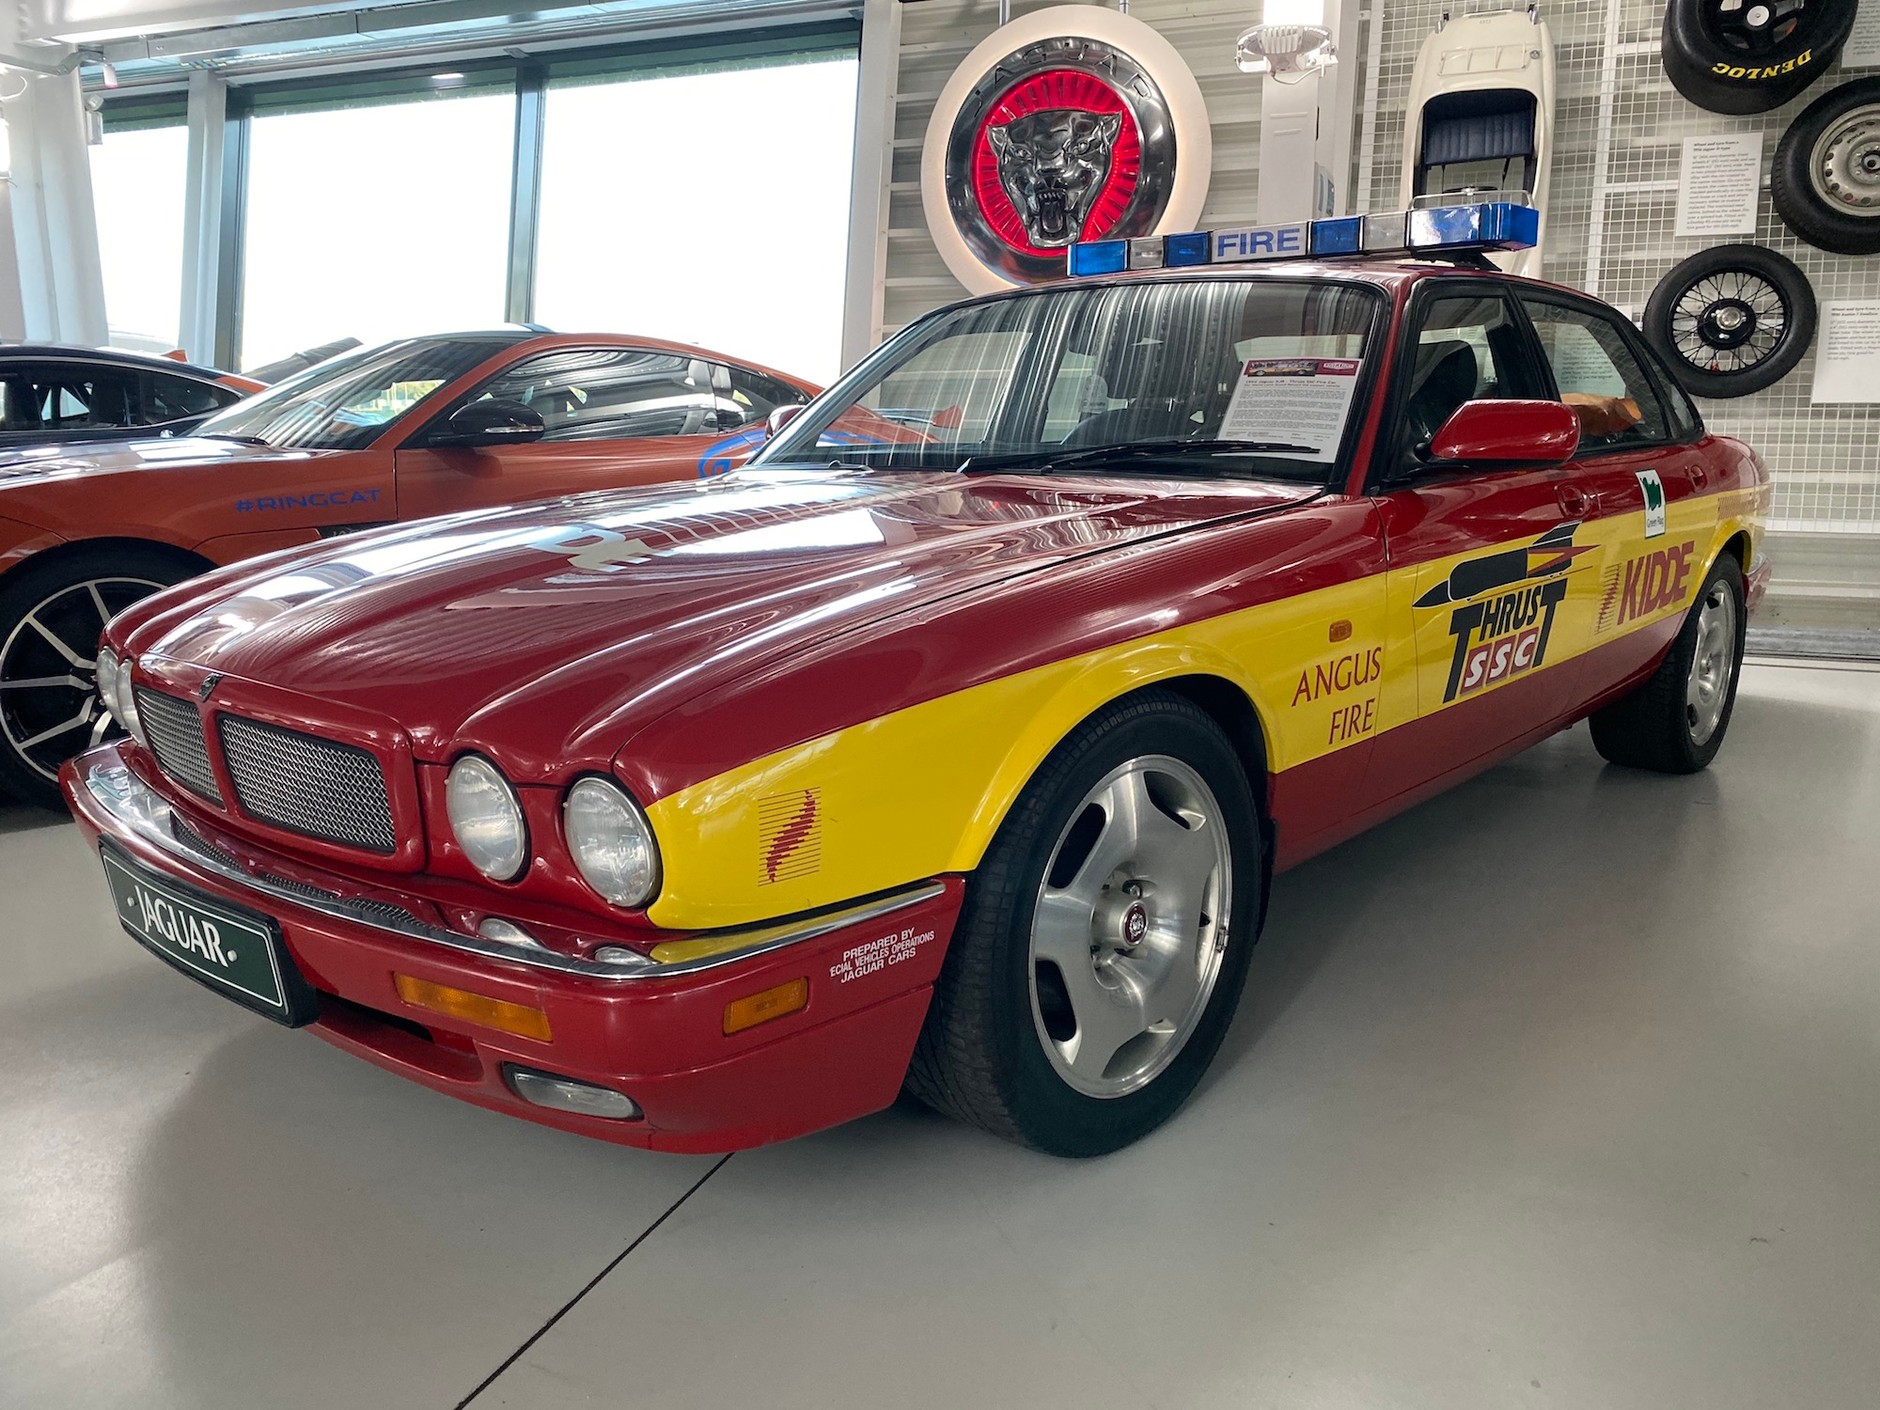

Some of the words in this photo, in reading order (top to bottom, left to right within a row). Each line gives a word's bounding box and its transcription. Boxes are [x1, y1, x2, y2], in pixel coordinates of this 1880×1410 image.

[973, 42, 1151, 118] JAGUAR
[1711, 48, 1812, 79] DENLOC
[1217, 228, 1300, 257] FIRE
[235, 488, 381, 512] #RINGCAT
[1617, 540, 1694, 625] KIDDE
[1442, 578, 1568, 704] THRUST
[1464, 633, 1536, 687] SSC
[1291, 646, 1382, 707] ANGUS
[1328, 697, 1375, 745] FIRE
[135, 885, 228, 967] JAGUAR
[843, 934, 898, 961] PREPARED
[901, 927, 915, 940] BY
[829, 961, 853, 977] ECIAL
[855, 947, 889, 967] VEHICLES
[891, 930, 935, 953] OPERATIONS
[841, 959, 884, 983] JAGUAR
[888, 947, 916, 965] CARS
